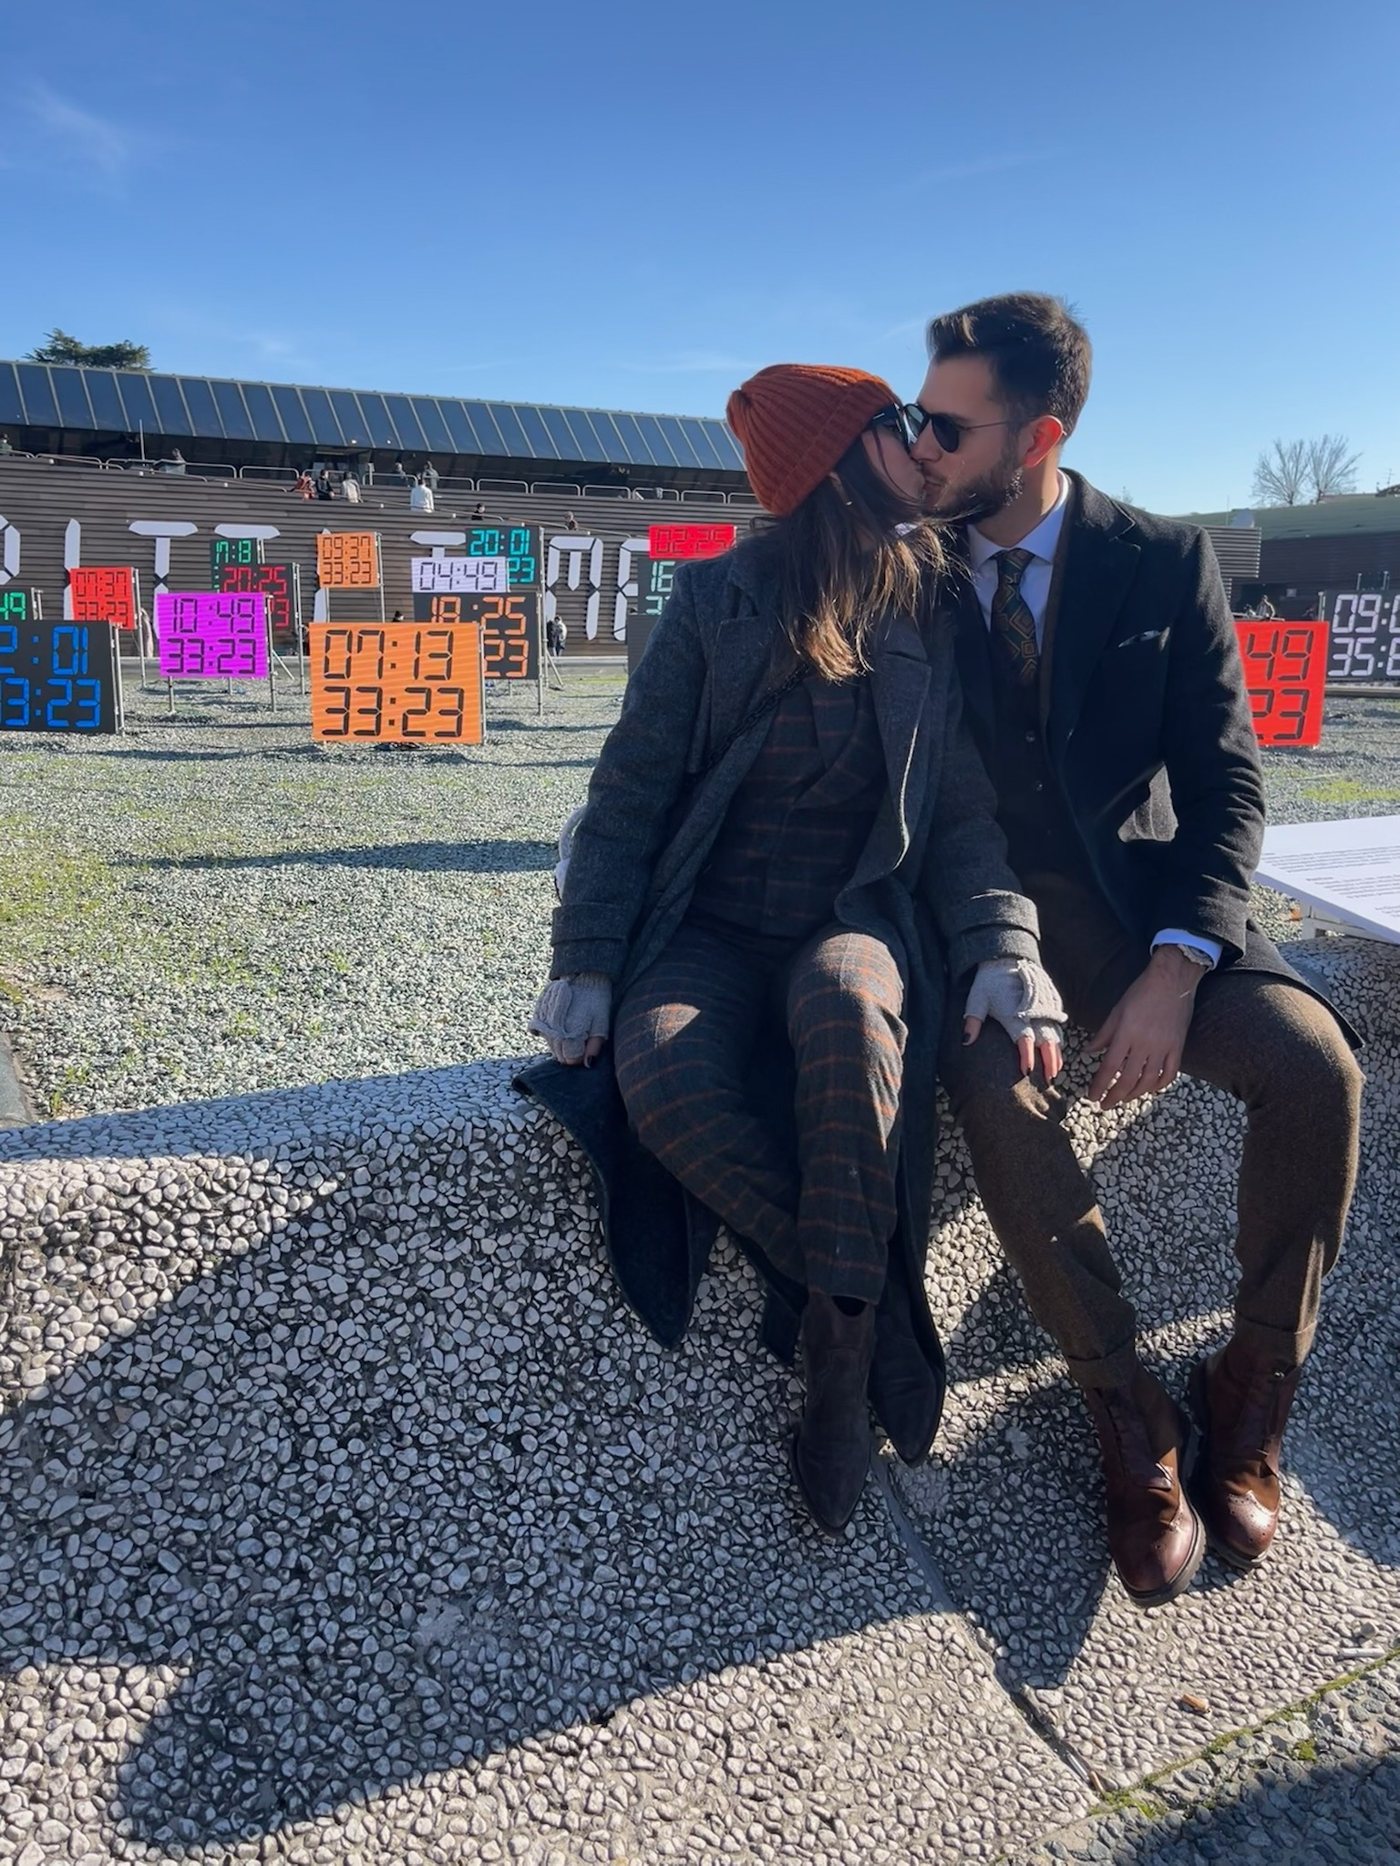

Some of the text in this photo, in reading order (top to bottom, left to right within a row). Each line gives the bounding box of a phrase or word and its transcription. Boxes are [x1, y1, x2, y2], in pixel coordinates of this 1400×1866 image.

[216, 540, 251, 563] 17:13
[322, 536, 371, 560] 09:37
[470, 529, 530, 555] 20:01
[76, 571, 127, 597] 07:37
[322, 561, 371, 585] 33:23
[420, 562, 498, 591] 04:49
[174, 599, 256, 634] 10:49
[166, 638, 257, 674] 33:23
[323, 629, 454, 681] 07:13
[321, 686, 465, 738] 33:23
